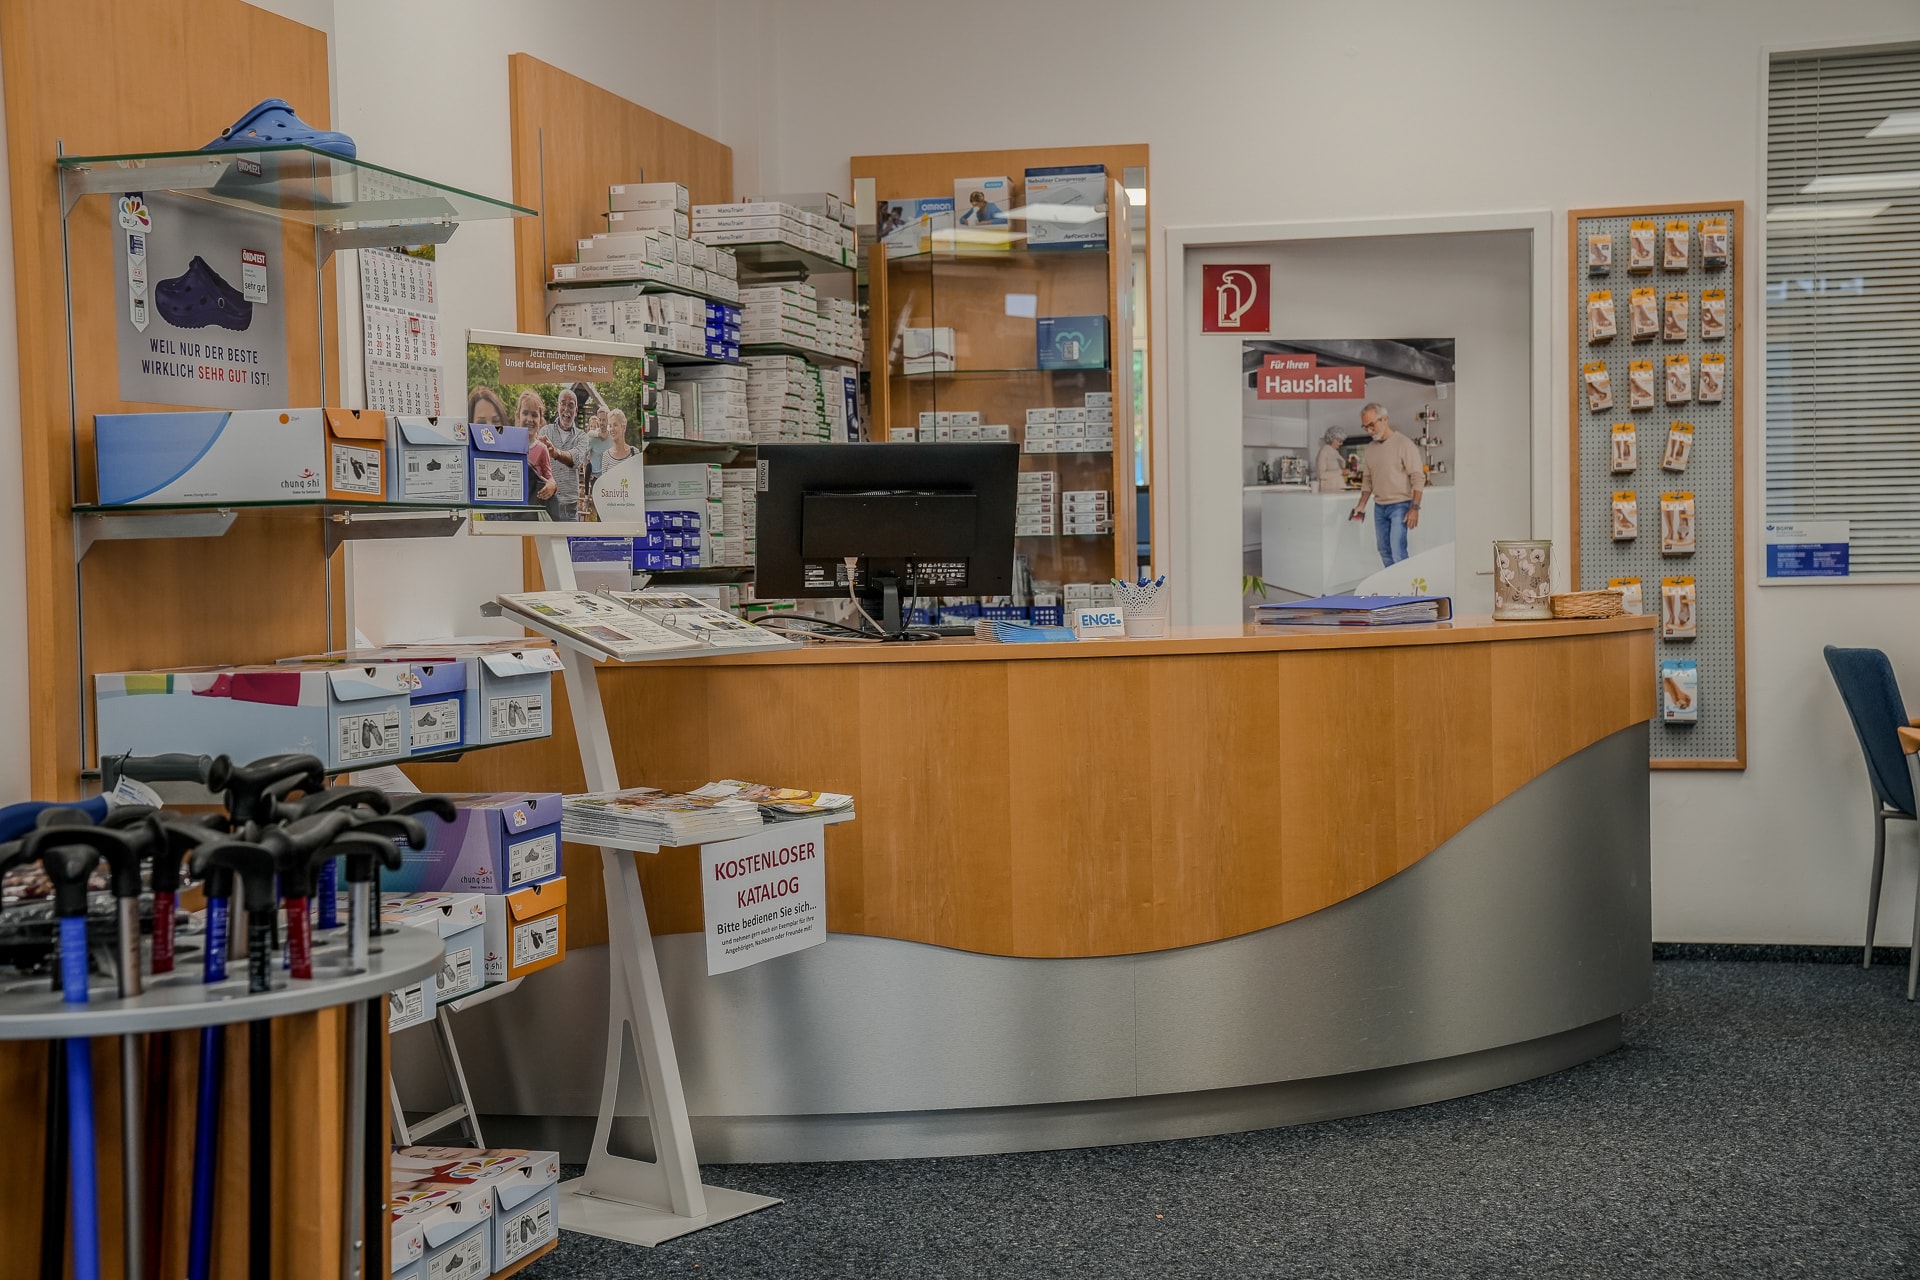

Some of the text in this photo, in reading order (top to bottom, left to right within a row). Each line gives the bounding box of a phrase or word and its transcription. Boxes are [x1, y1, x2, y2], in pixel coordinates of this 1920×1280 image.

[922, 202, 951, 212] OMRON
[245, 281, 266, 293] sehr gut
[150, 338, 258, 364] WEIL NUR DER BESTE
[530, 350, 585, 361] Jetzt mitnehmen!
[505, 359, 608, 374] Unser Katalog liegt für Sie bereit.
[1270, 360, 1309, 370] Für Ihren
[142, 360, 270, 386] WIRKLICH SEHR GUT IST!
[1265, 374, 1352, 393] Haushalt
[281, 479, 319, 488] chung shi
[601, 489, 628, 498] Sanivita
[1082, 613, 1121, 626] ENGE.
[715, 842, 815, 881] KOSTENLOSER
[460, 876, 480, 884] chung
[737, 877, 799, 908] KATALOG
[717, 901, 816, 934] Bitte bedienen Sie sich...
[733, 933, 751, 943] nehmen
[751, 931, 760, 939] gern
[761, 927, 770, 935] auch
[778, 919, 798, 931] Exemplar
[725, 942, 754, 955] Angehörigen,
[755, 936, 774, 947] Nachbarn
[775, 932, 785, 941] oder
[786, 928, 803, 938] Freunde
[492, 962, 502, 970] shi
